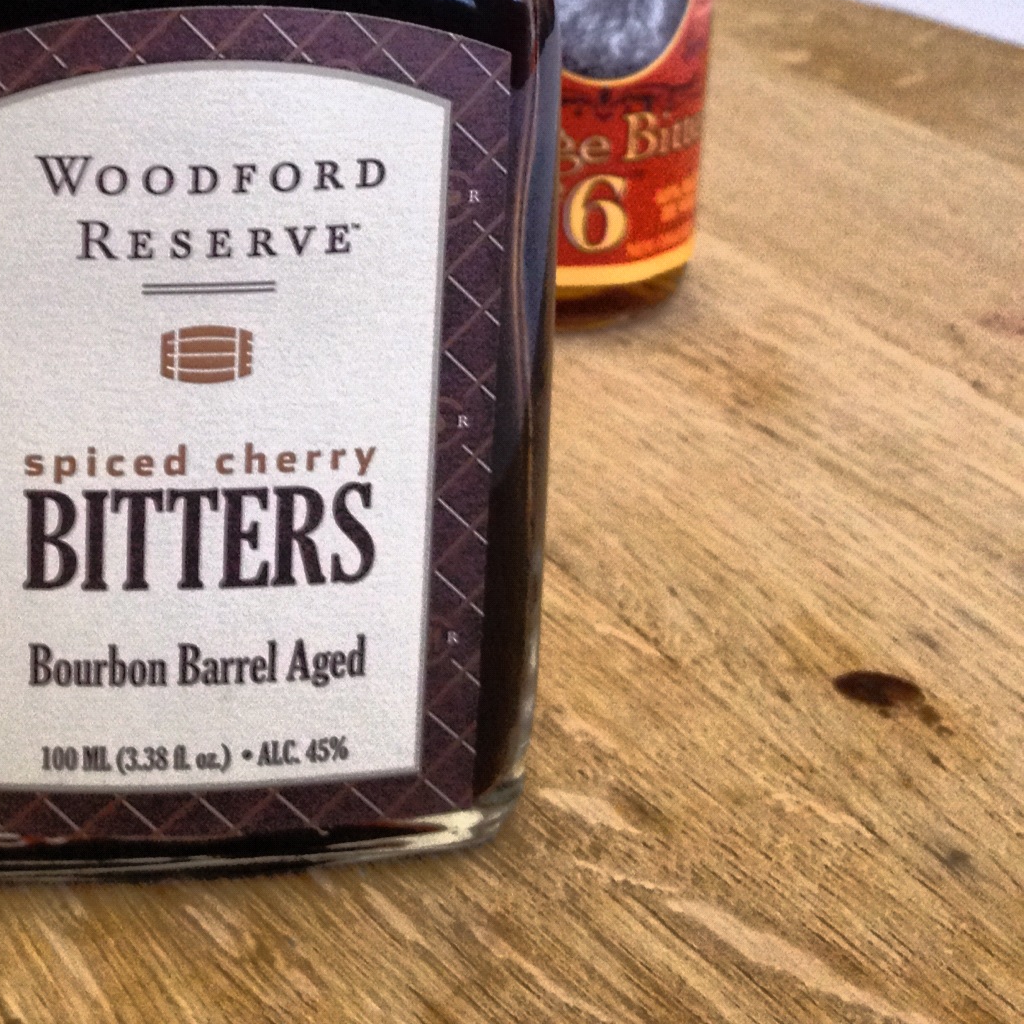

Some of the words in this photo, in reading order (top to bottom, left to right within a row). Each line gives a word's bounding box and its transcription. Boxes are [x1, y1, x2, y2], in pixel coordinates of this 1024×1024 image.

[36, 154, 388, 198] WOODFORD
[563, 173, 628, 254] 6
[76, 220, 352, 261] RESERVE
[24, 445, 188, 483] spiced
[215, 442, 377, 476] cherry
[23, 481, 377, 592] BITTERS
[28, 642, 168, 689] Bourbon
[177, 639, 277, 687] Barrel
[286, 634, 366, 684] Aged
[41, 745, 77, 772] 100
[116, 745, 169, 776] (3.38
[305, 735, 349, 764] 45%
